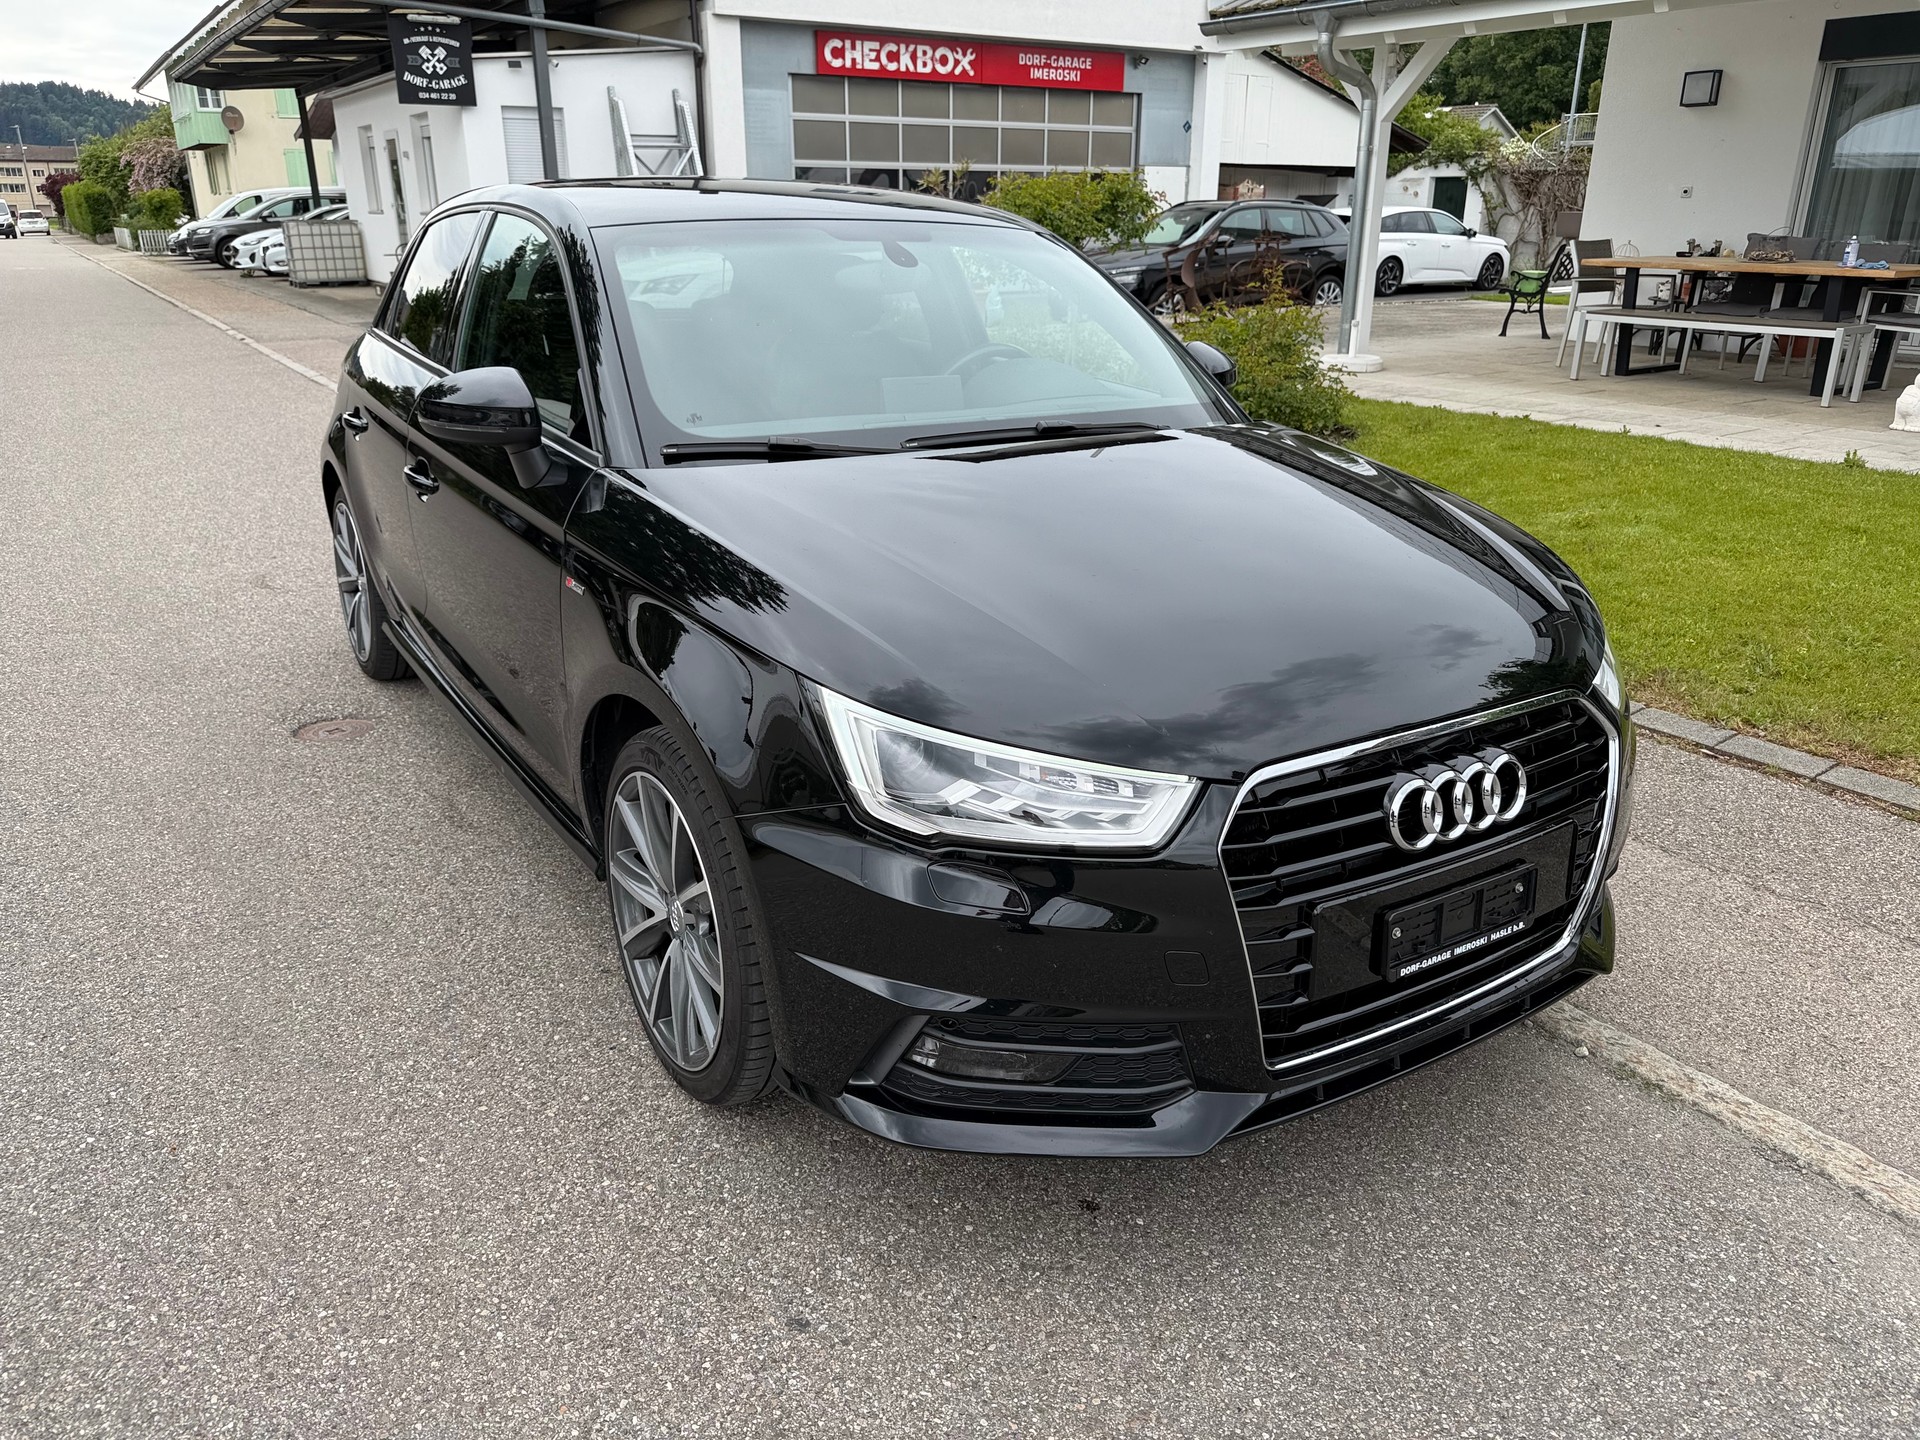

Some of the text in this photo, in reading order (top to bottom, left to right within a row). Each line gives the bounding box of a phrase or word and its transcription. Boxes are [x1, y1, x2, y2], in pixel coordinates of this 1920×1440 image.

[824, 38, 976, 76] CHECKBOX
[1018, 53, 1092, 69] DORF-GARAGE
[402, 71, 468, 90] DORF-GARAGE
[1030, 68, 1080, 82] IMEROSKI
[668, 766, 689, 796] OUTSIDE
[1400, 950, 1452, 976] DORF-GARAGE
[1454, 936, 1488, 956] IMEROSKI
[1490, 926, 1512, 941] HASLE
